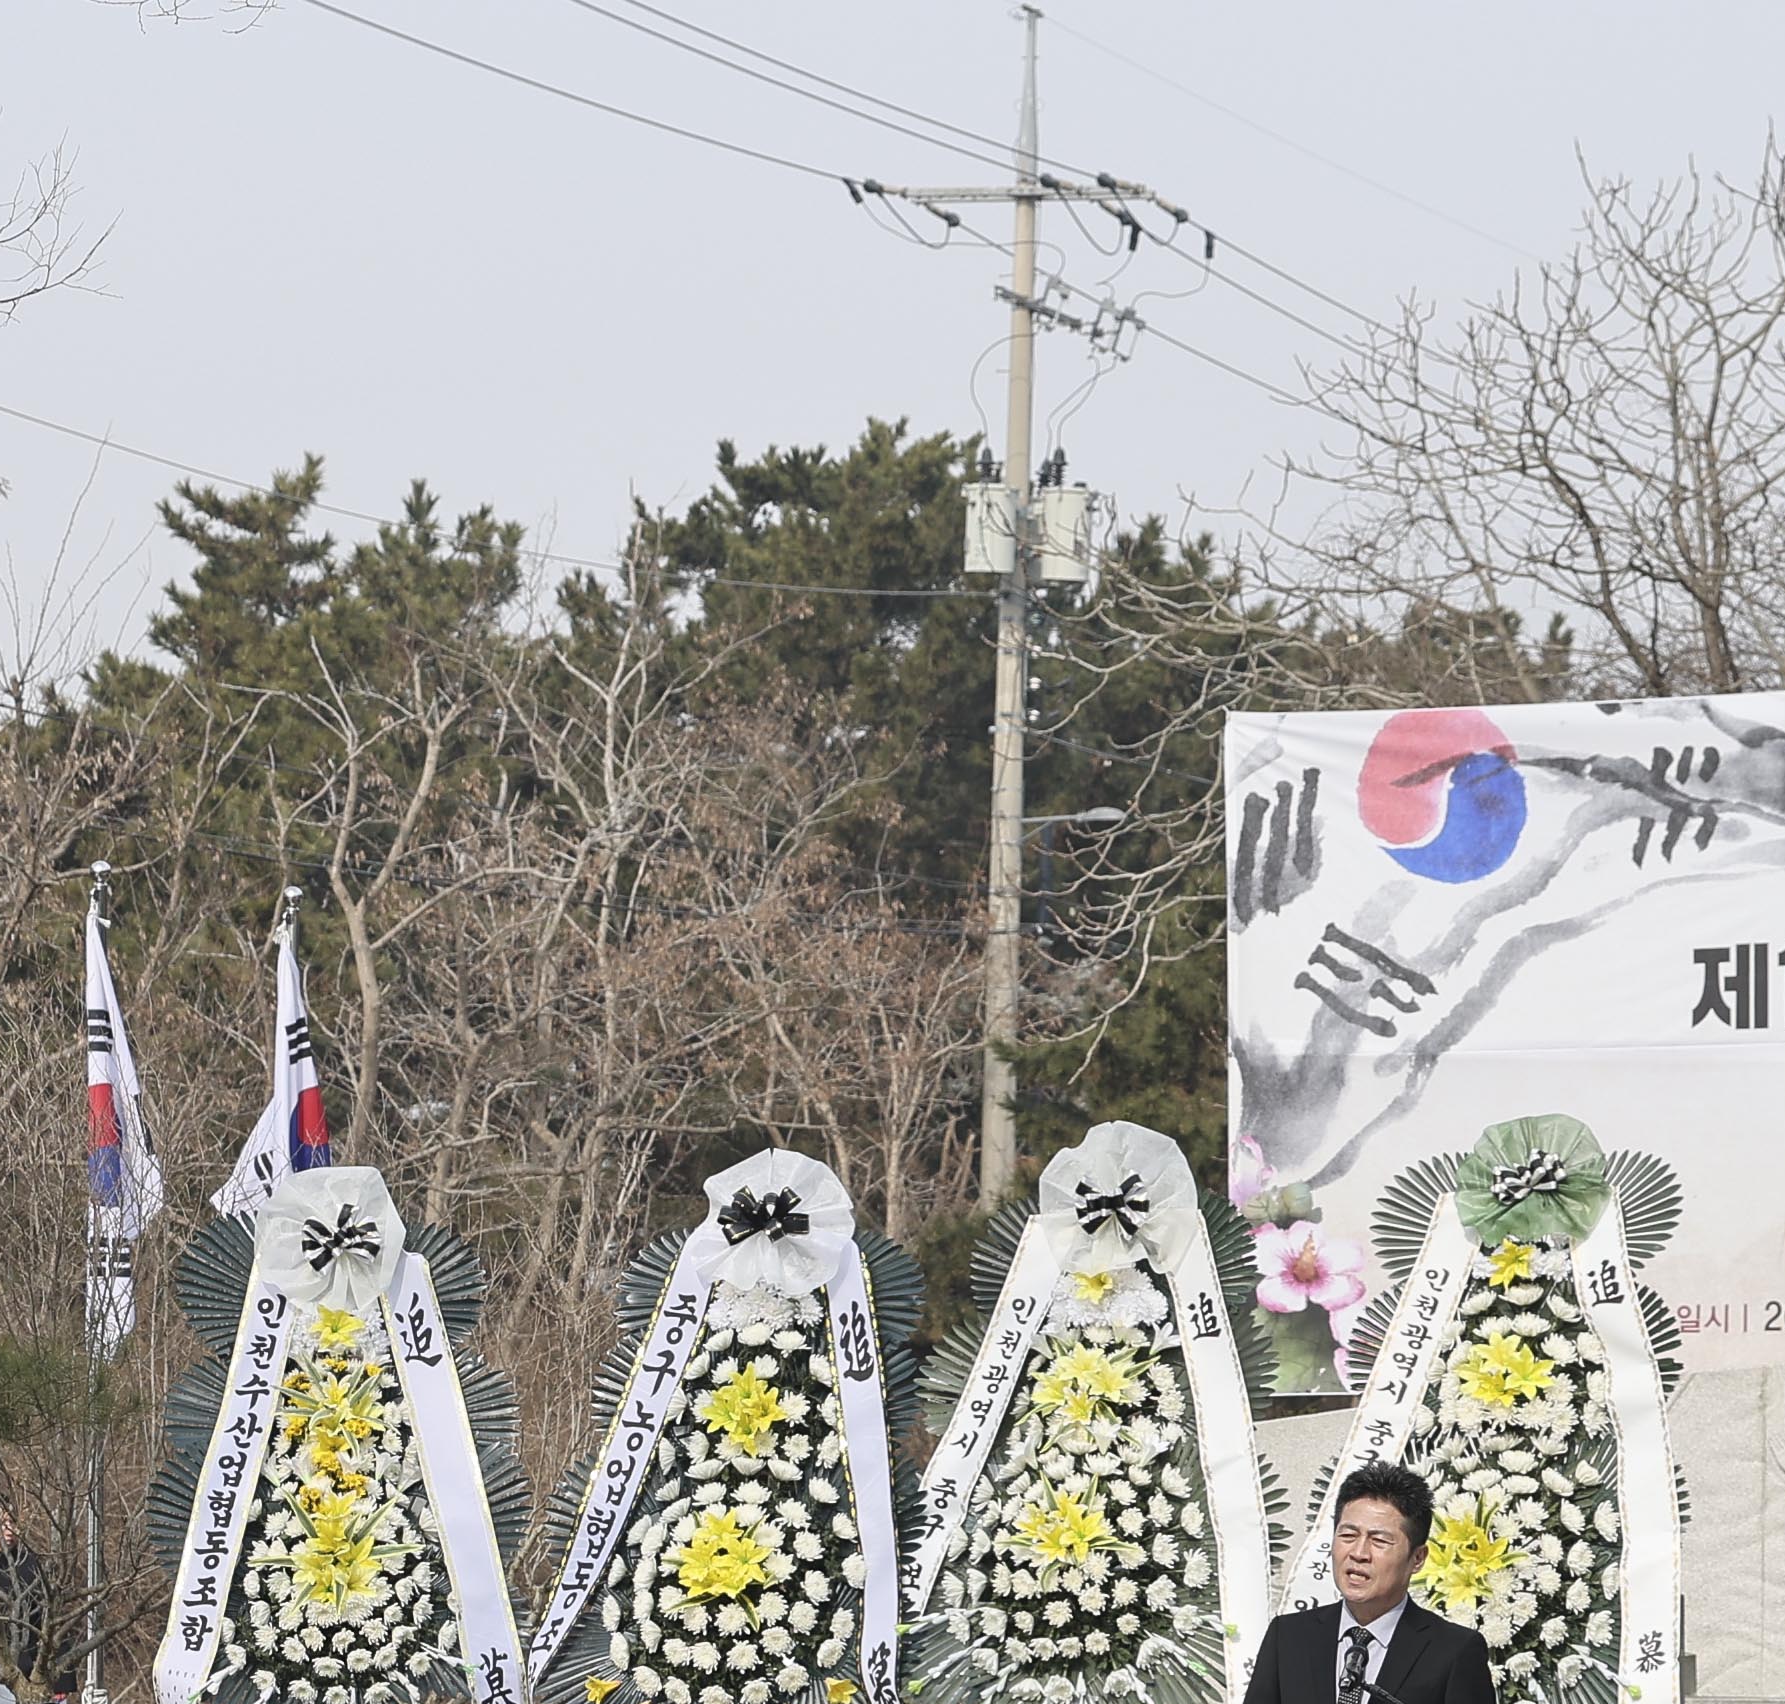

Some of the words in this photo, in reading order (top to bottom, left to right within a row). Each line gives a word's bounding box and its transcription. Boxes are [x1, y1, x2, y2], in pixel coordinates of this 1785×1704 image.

[950, 1295, 1037, 1459] 인천광역시
[1377, 1267, 1450, 1405] 인천광역시
[1677, 1302, 1729, 1334] 일시
[180, 1291, 289, 1652] 인천수산업협동조합
[920, 1477, 957, 1541] 중구
